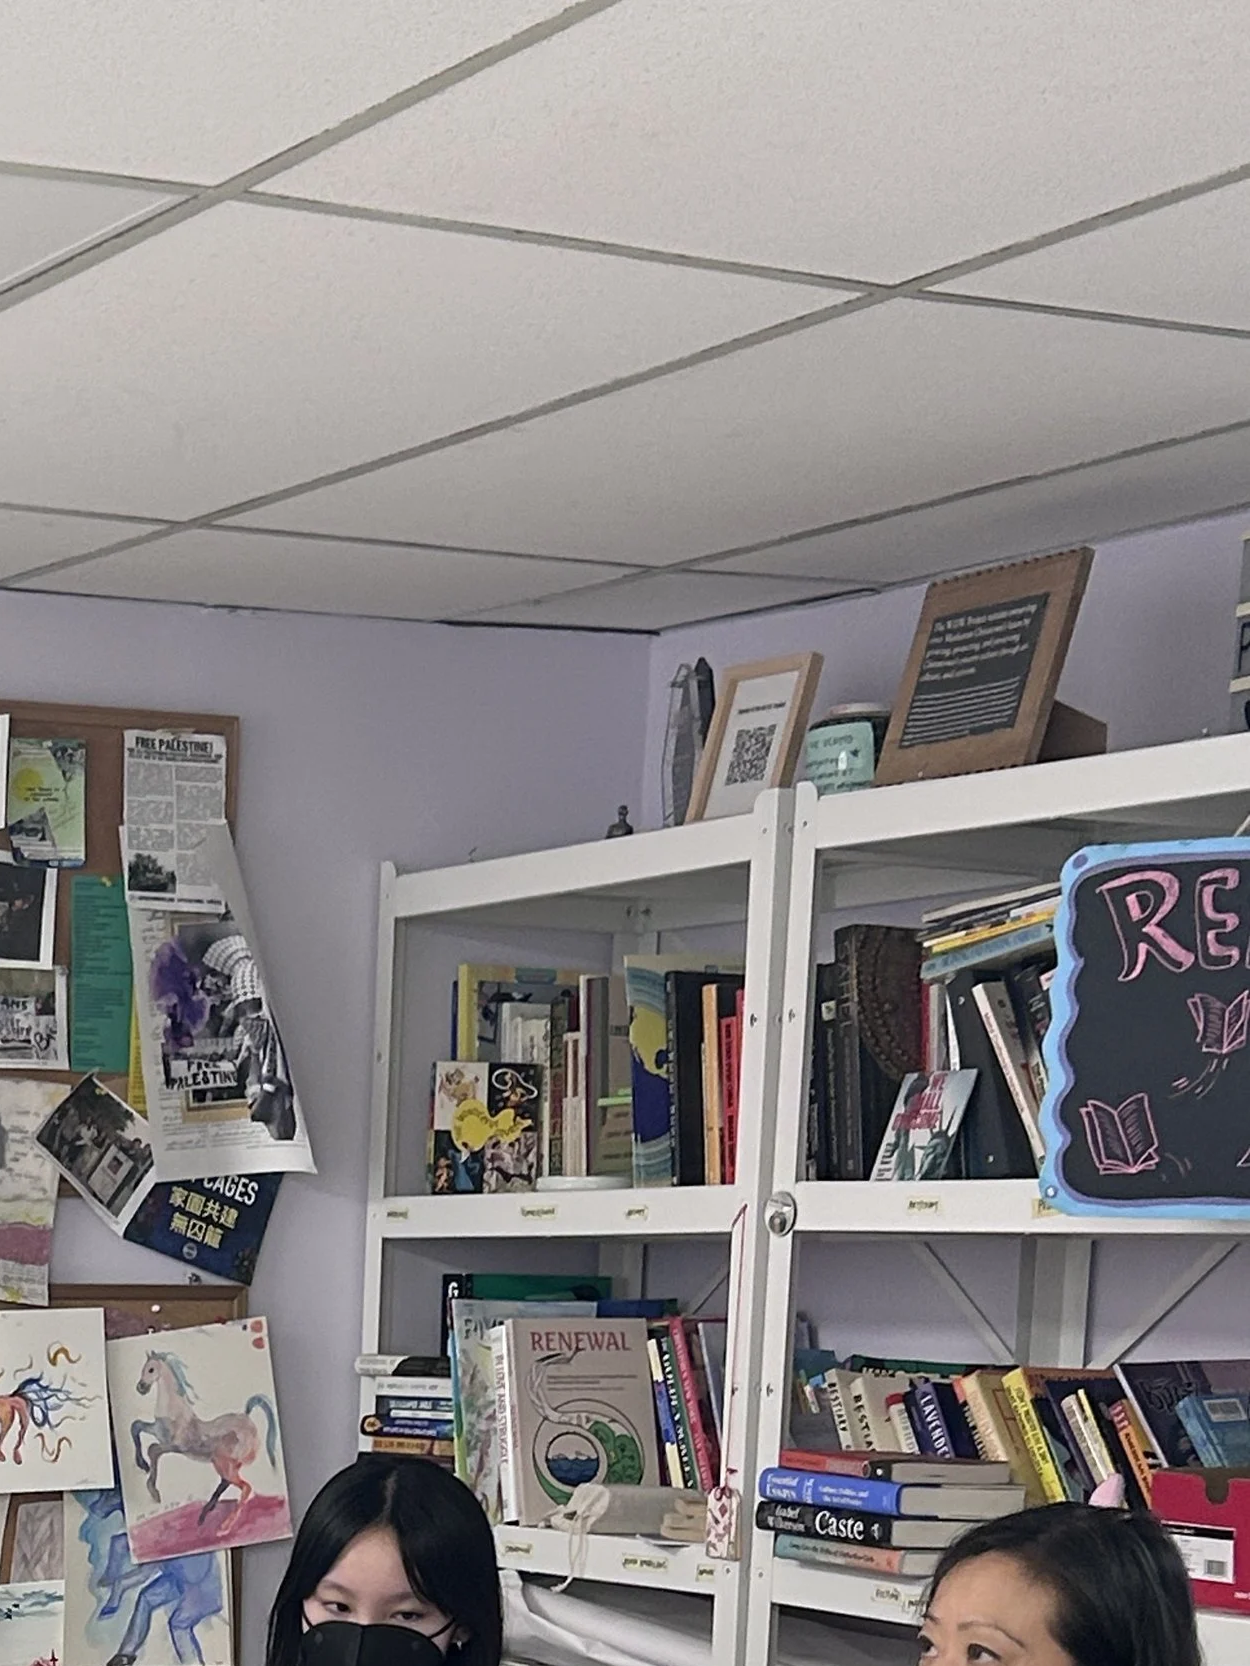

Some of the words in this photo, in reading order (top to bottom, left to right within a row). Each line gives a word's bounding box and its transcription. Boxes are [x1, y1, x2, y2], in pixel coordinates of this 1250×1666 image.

[135, 736, 157, 750] FREE
[1095, 868, 1250, 982] RE
[203, 1175, 259, 1206] CAGES
[530, 1331, 630, 1351] RENEWAL
[496, 1393, 507, 1415] AND
[828, 1382, 847, 1432] BESTIARY
[815, 1510, 865, 1540] Caste
